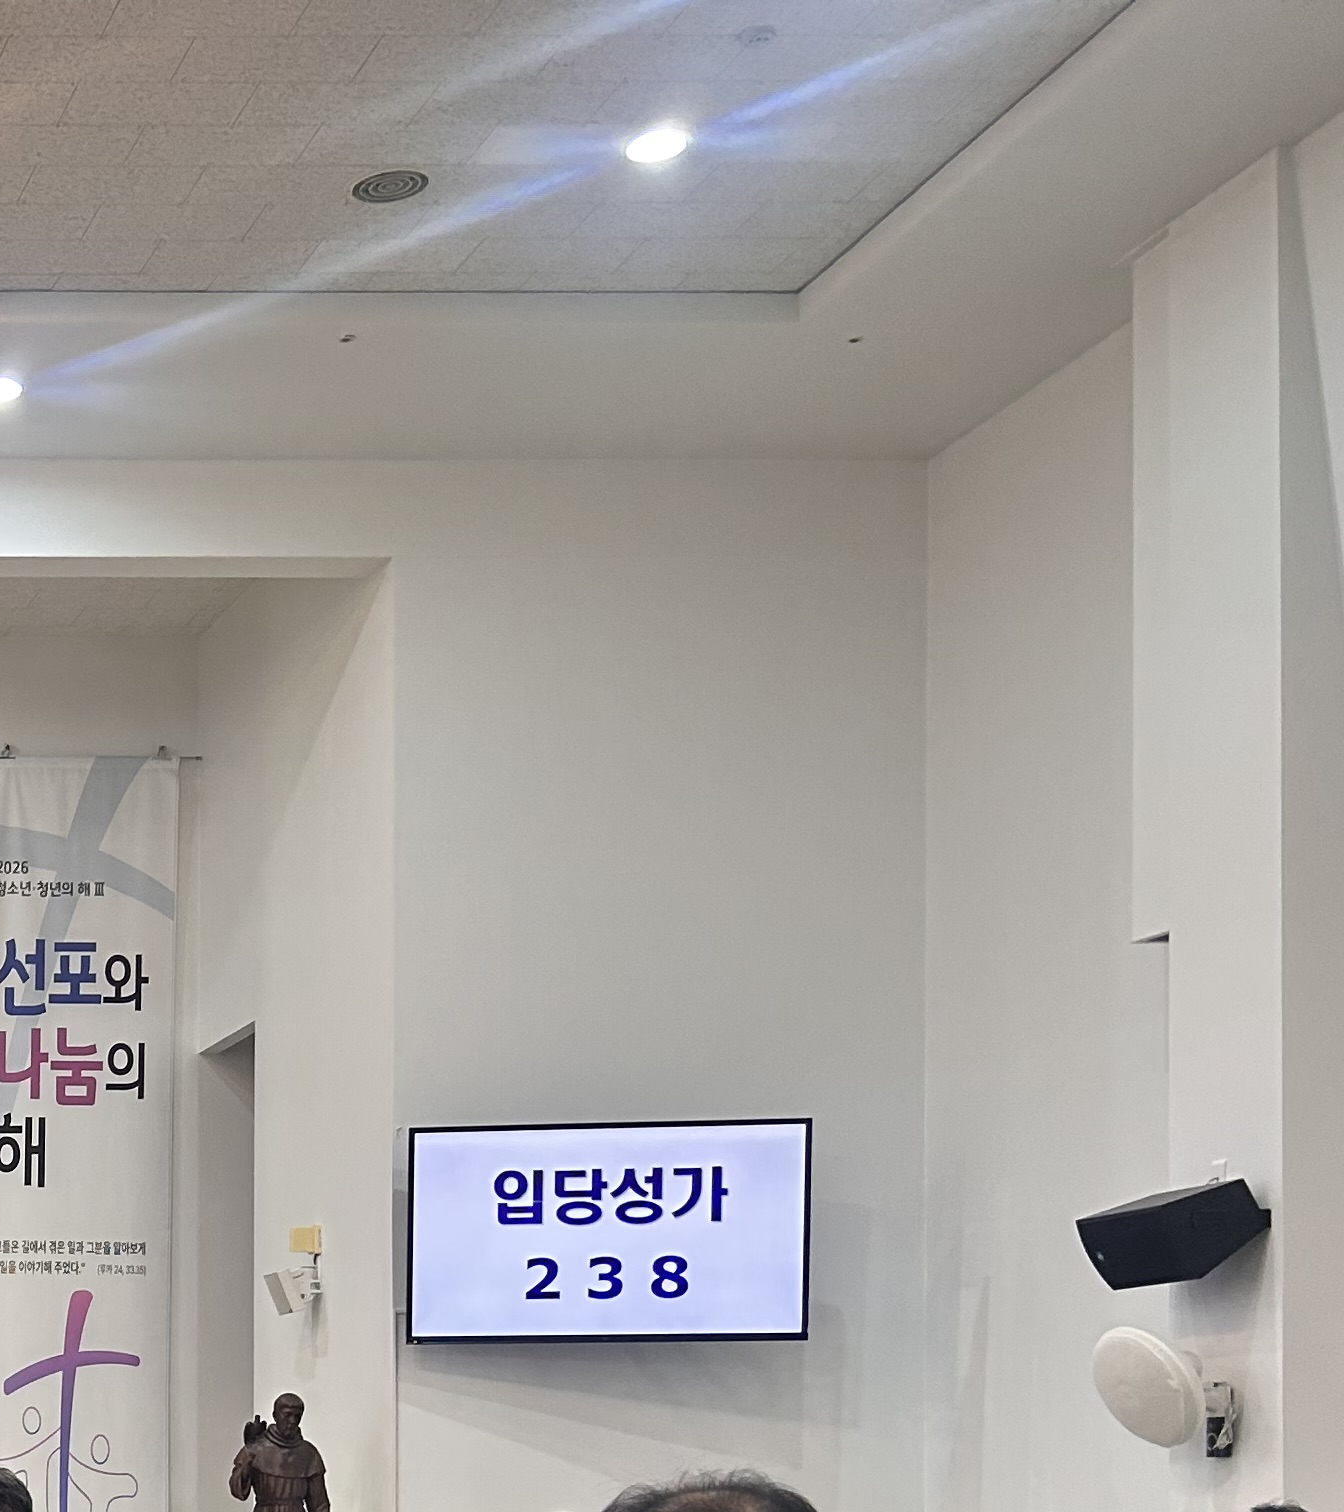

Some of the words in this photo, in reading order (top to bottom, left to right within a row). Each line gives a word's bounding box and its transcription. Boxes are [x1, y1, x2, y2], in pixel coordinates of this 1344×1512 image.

[77, 881, 91, 897] 해
[493, 1165, 729, 1226] 입당성가
[22, 1240, 47, 1254] 길에서
[67, 1240, 84, 1255] 일과
[86, 1241, 111, 1255] 그분을
[113, 1241, 146, 1256] 알아보게
[0, 1260, 16, 1274] 일을
[19, 1260, 52, 1275] 이야기해
